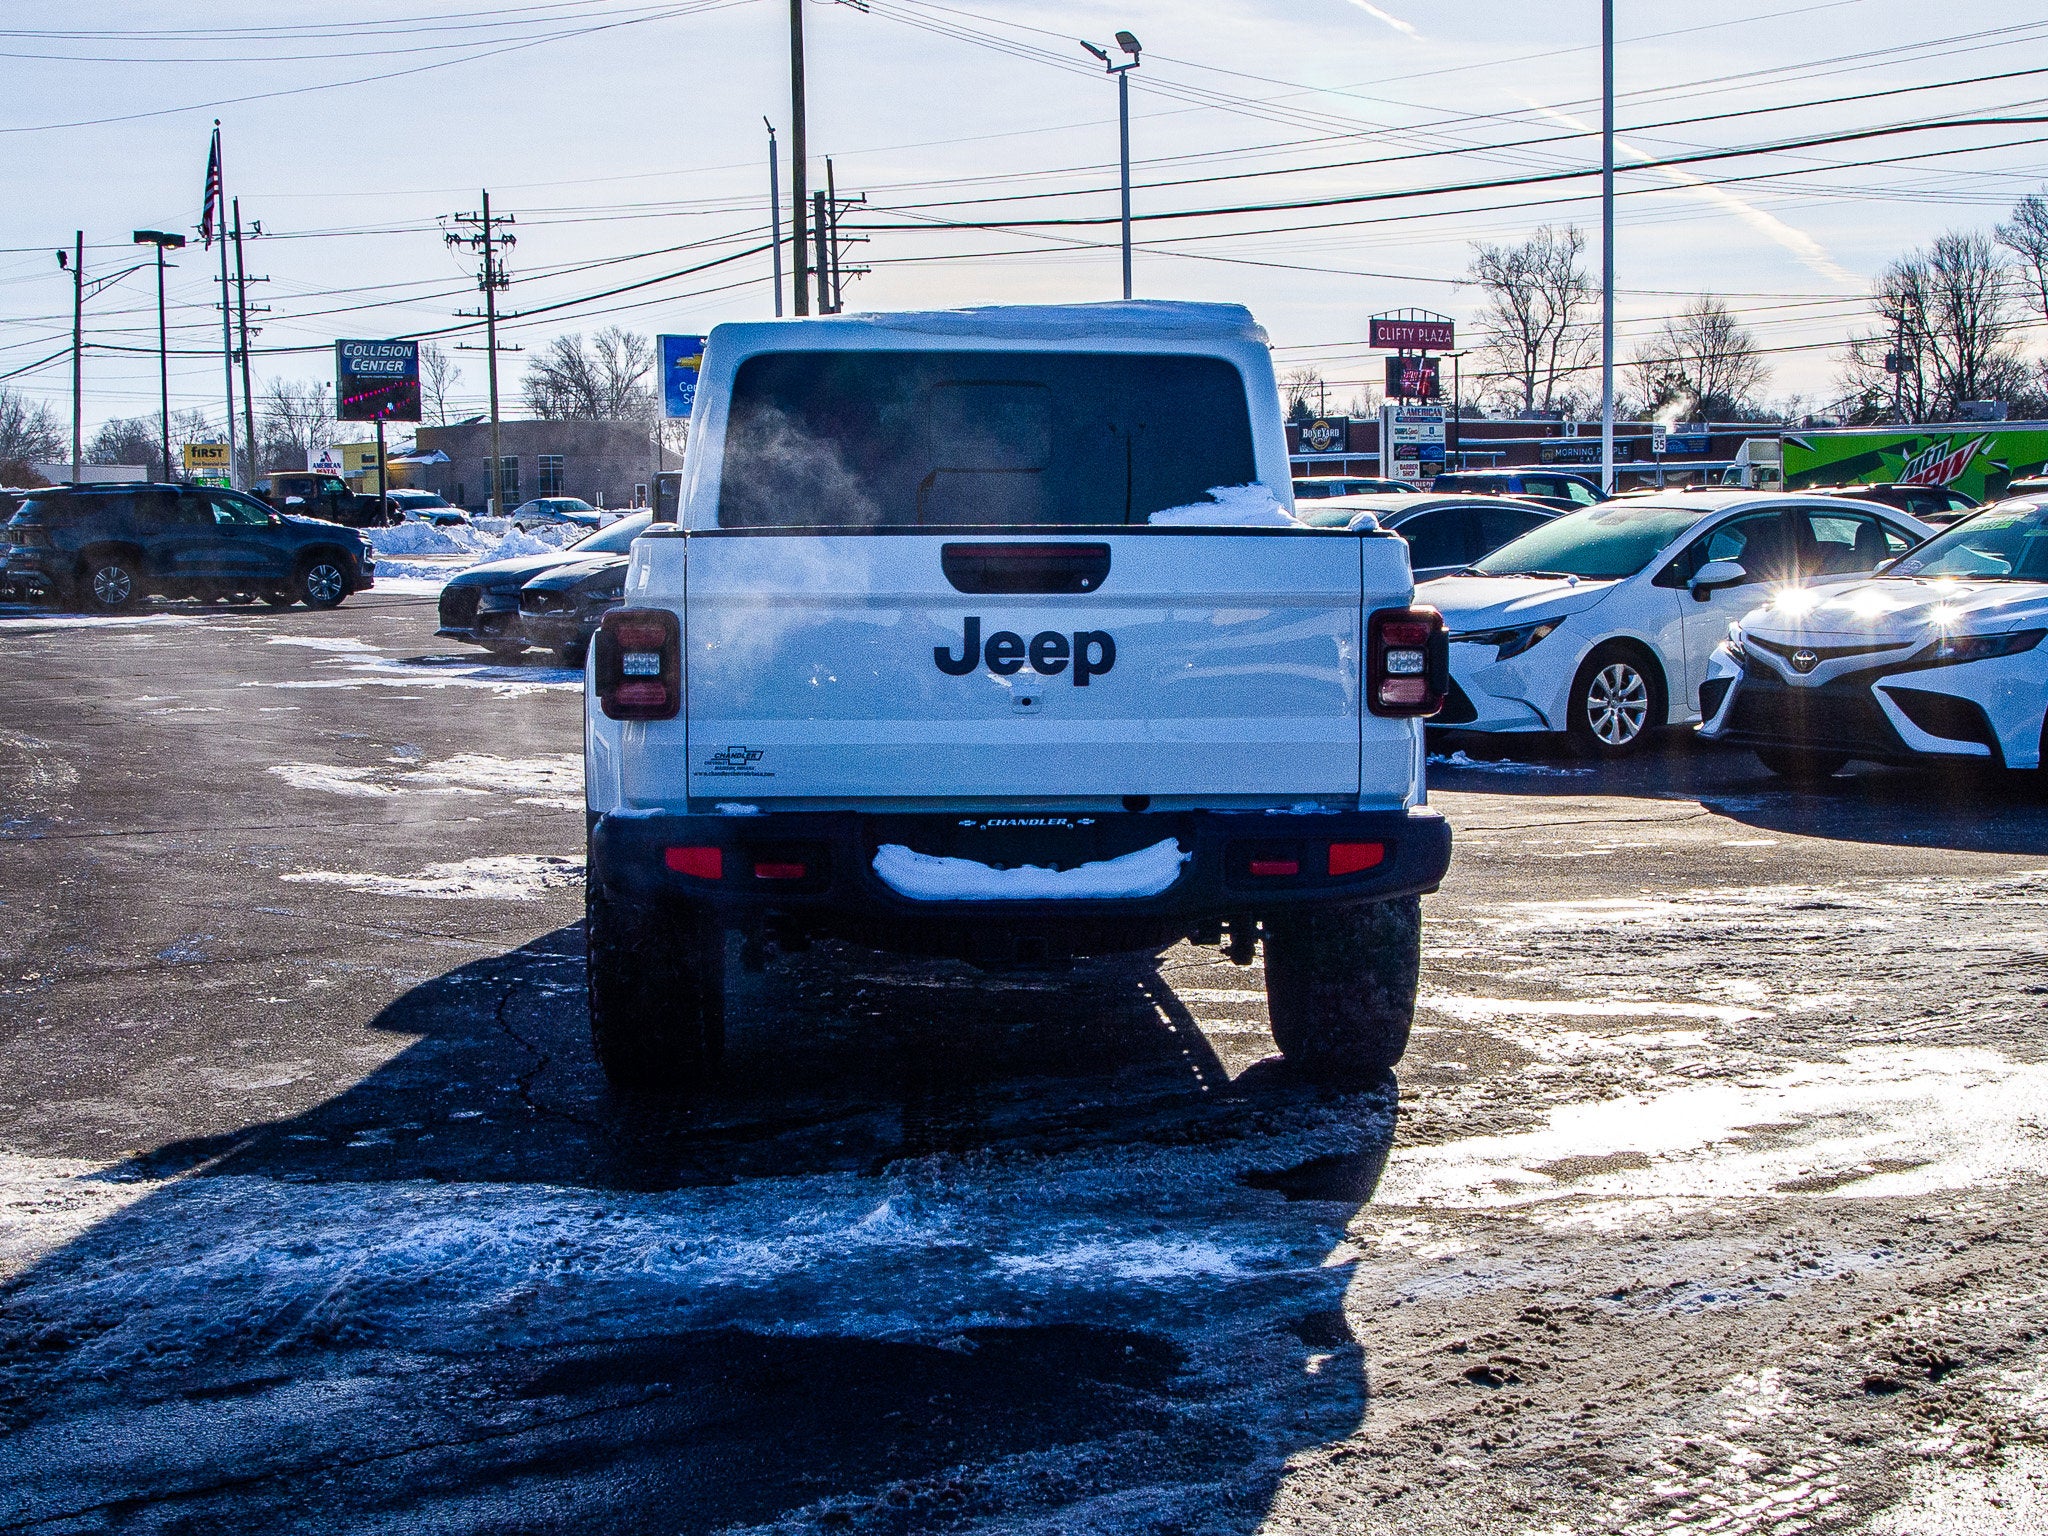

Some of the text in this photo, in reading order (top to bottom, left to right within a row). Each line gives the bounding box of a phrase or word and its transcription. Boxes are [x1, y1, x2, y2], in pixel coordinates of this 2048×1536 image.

[1378, 327, 1452, 343] CLIFTY PLAZA
[344, 343, 413, 357] COLLISION
[351, 359, 404, 371] CENTER
[1406, 407, 1443, 416] AMERICAN
[1654, 439, 1665, 450] 35
[1555, 446, 1628, 457] MORNING PPLE
[934, 616, 1116, 686] Jeep
[987, 818, 1068, 826] CHANDLER
